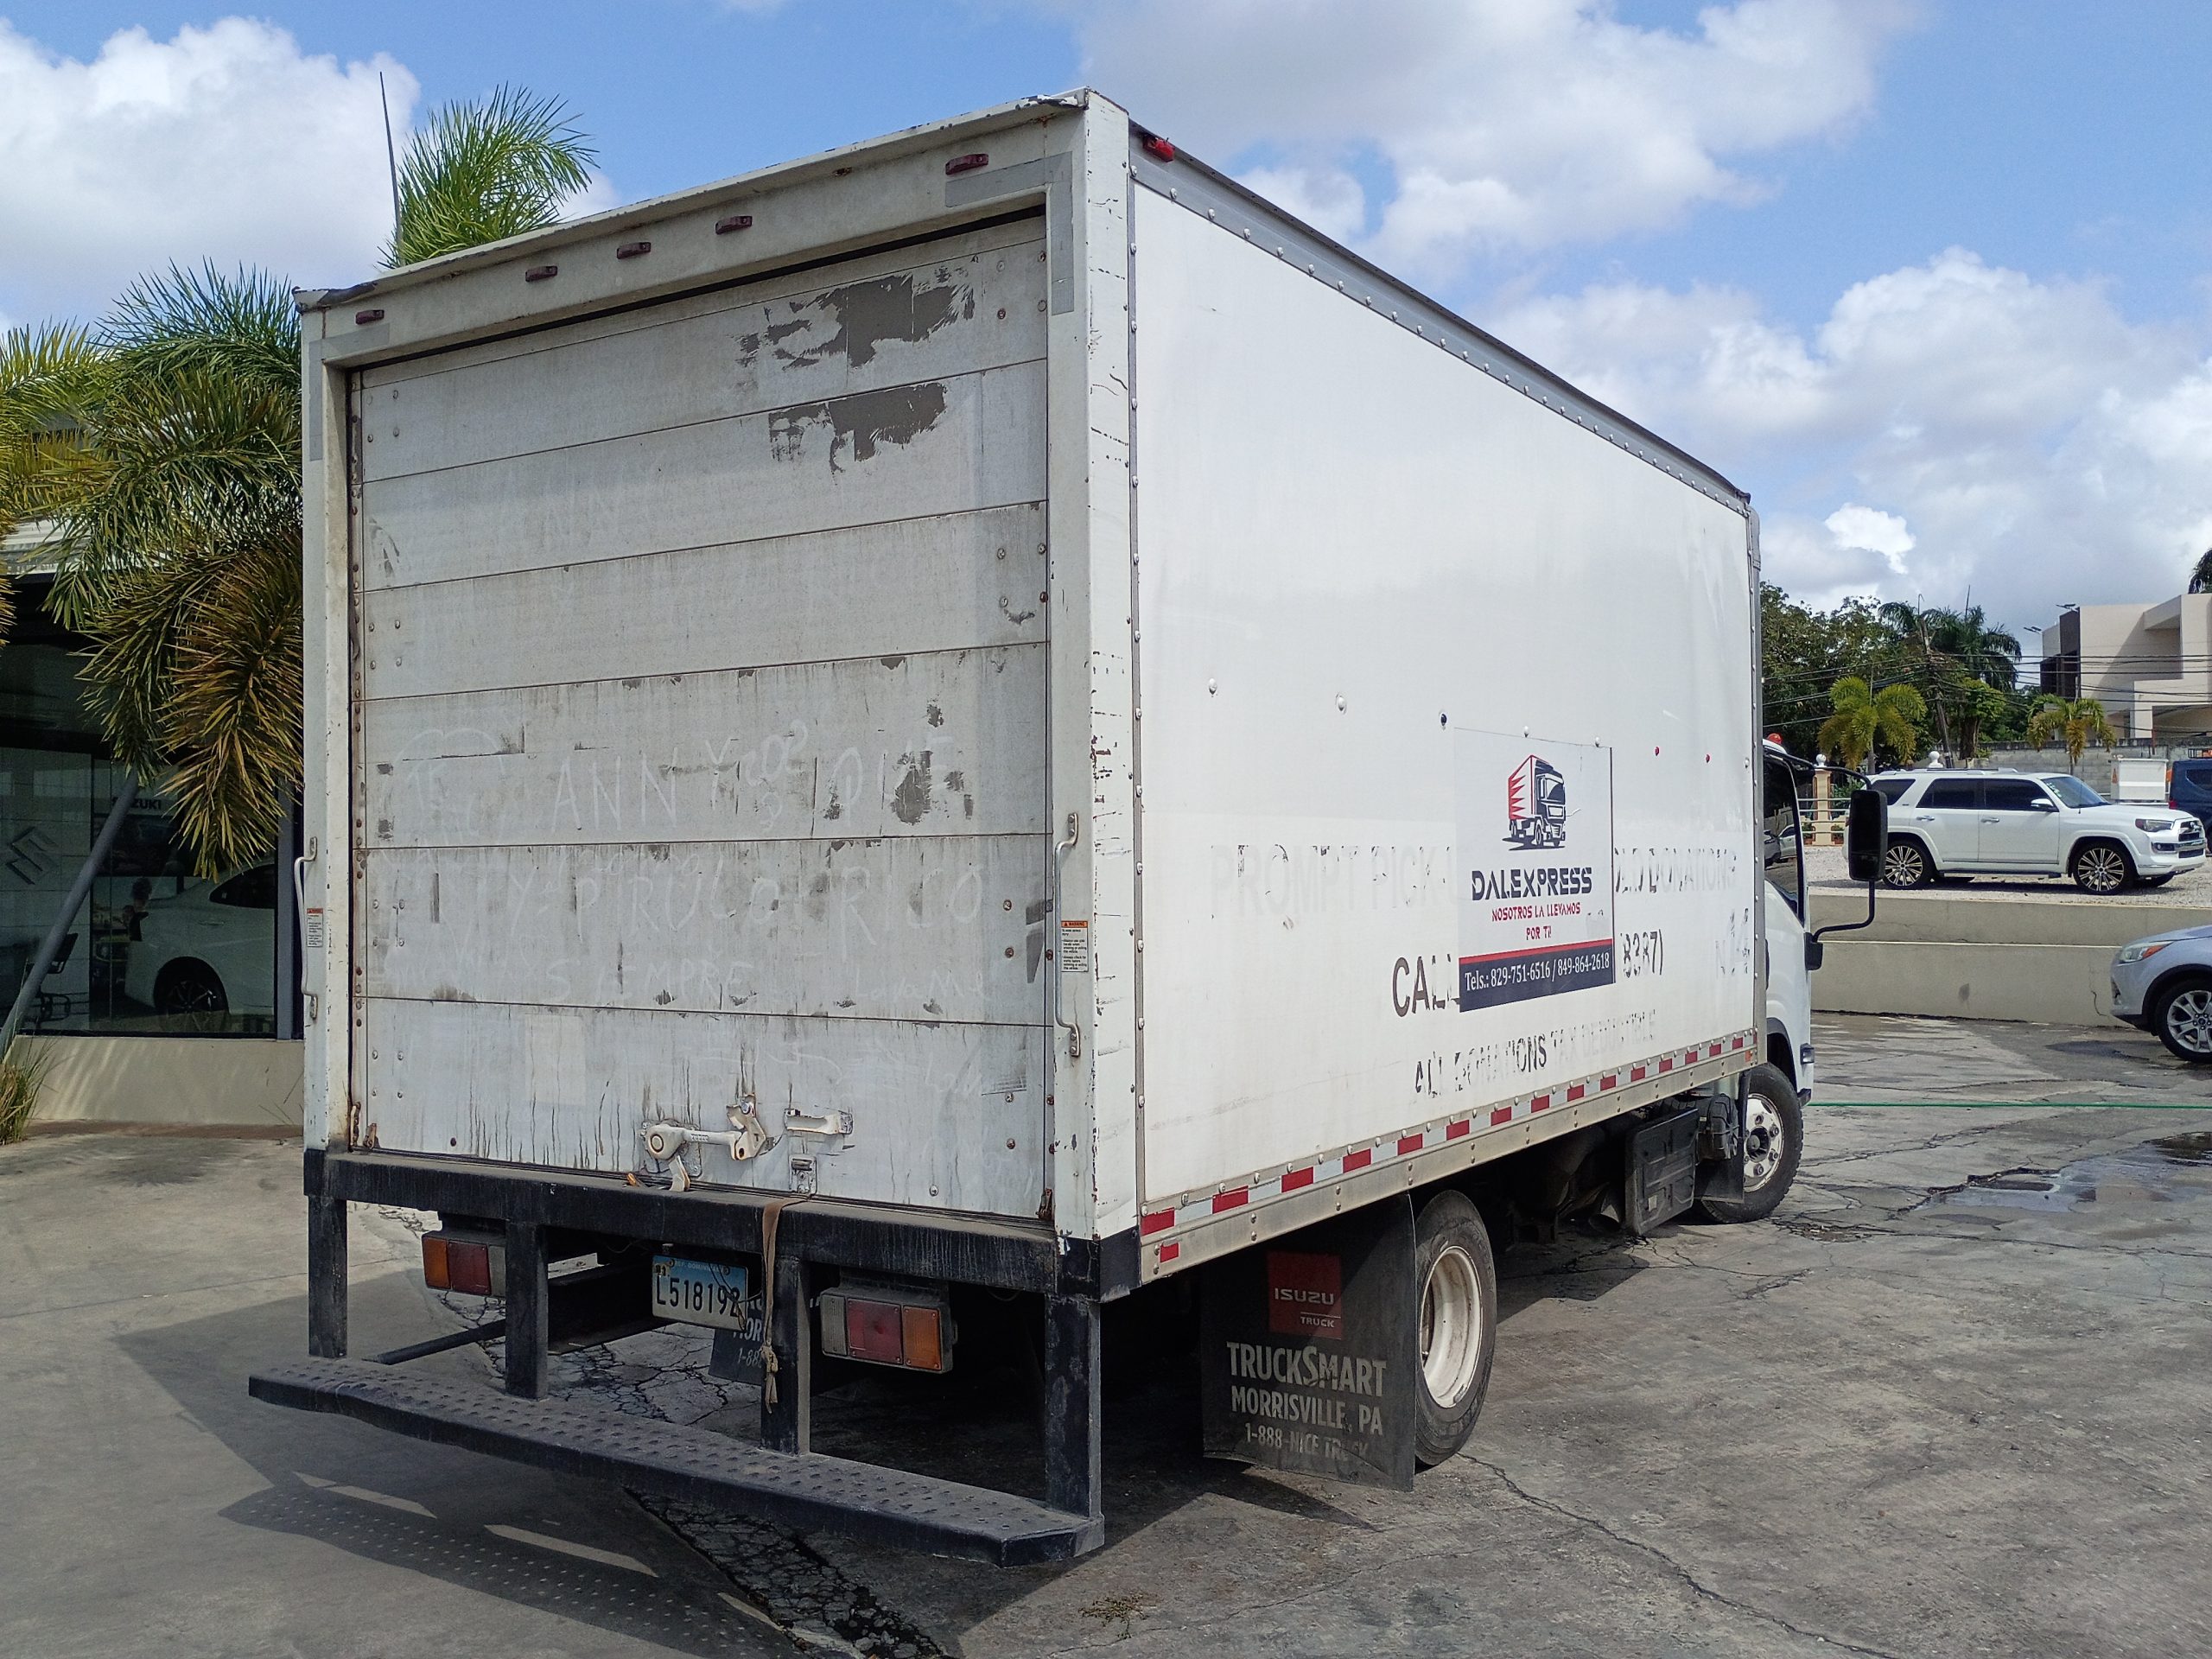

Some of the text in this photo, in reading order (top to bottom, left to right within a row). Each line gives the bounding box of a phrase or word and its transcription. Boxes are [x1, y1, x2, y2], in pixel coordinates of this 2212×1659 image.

[1471, 868, 1592, 900] DALEXPRESS
[1492, 902, 1580, 922] NOSOTROS LA LLEVAMOS
[1526, 926, 1541, 940] POR
[1465, 952, 1610, 991] Tels.: 829-751-6516 / 849-864-2618
[1274, 1287, 1334, 1306] ISUZU
[1300, 1316, 1335, 1328] TRUCK
[1226, 1341, 1387, 1398] TRUCKSMART
[1357, 1403, 1383, 1436] PA
